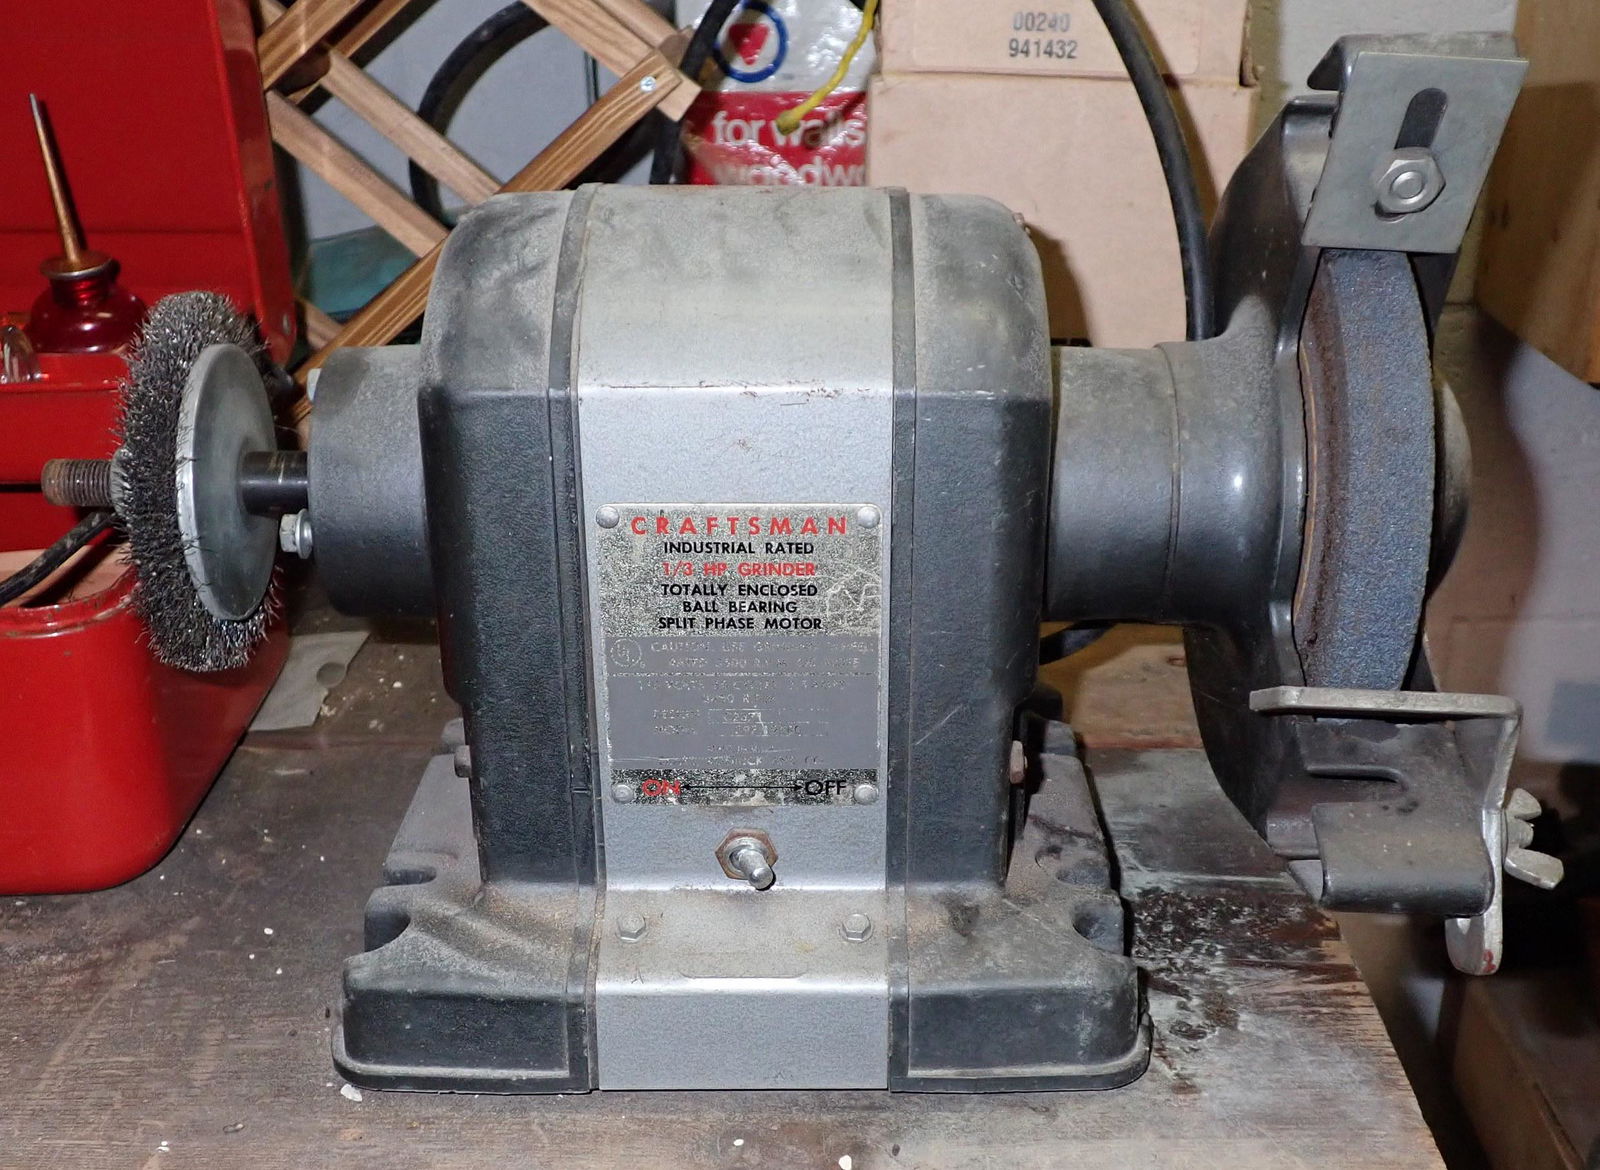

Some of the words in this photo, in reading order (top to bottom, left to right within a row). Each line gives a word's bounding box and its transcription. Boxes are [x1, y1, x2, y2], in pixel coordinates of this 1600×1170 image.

[1008, 38, 1078, 59] 941432
[711, 110, 767, 146] for
[630, 516, 848, 536] CRAFTSMAN
[663, 541, 755, 555] INDUSTRIAL
[765, 541, 815, 555] RATED
[662, 562, 693, 577] 1/3
[703, 562, 728, 577] HP
[737, 562, 816, 577] GRINDER
[661, 583, 728, 597] TOTALLY
[738, 583, 818, 597] ENCLOSED
[682, 601, 719, 613] BALL
[728, 601, 798, 613] BEARING
[658, 617, 696, 630] SPLIT
[705, 617, 755, 630] PHASE
[764, 617, 823, 630] MOTOR
[641, 778, 682, 797] ON
[804, 780, 847, 796] OFF
